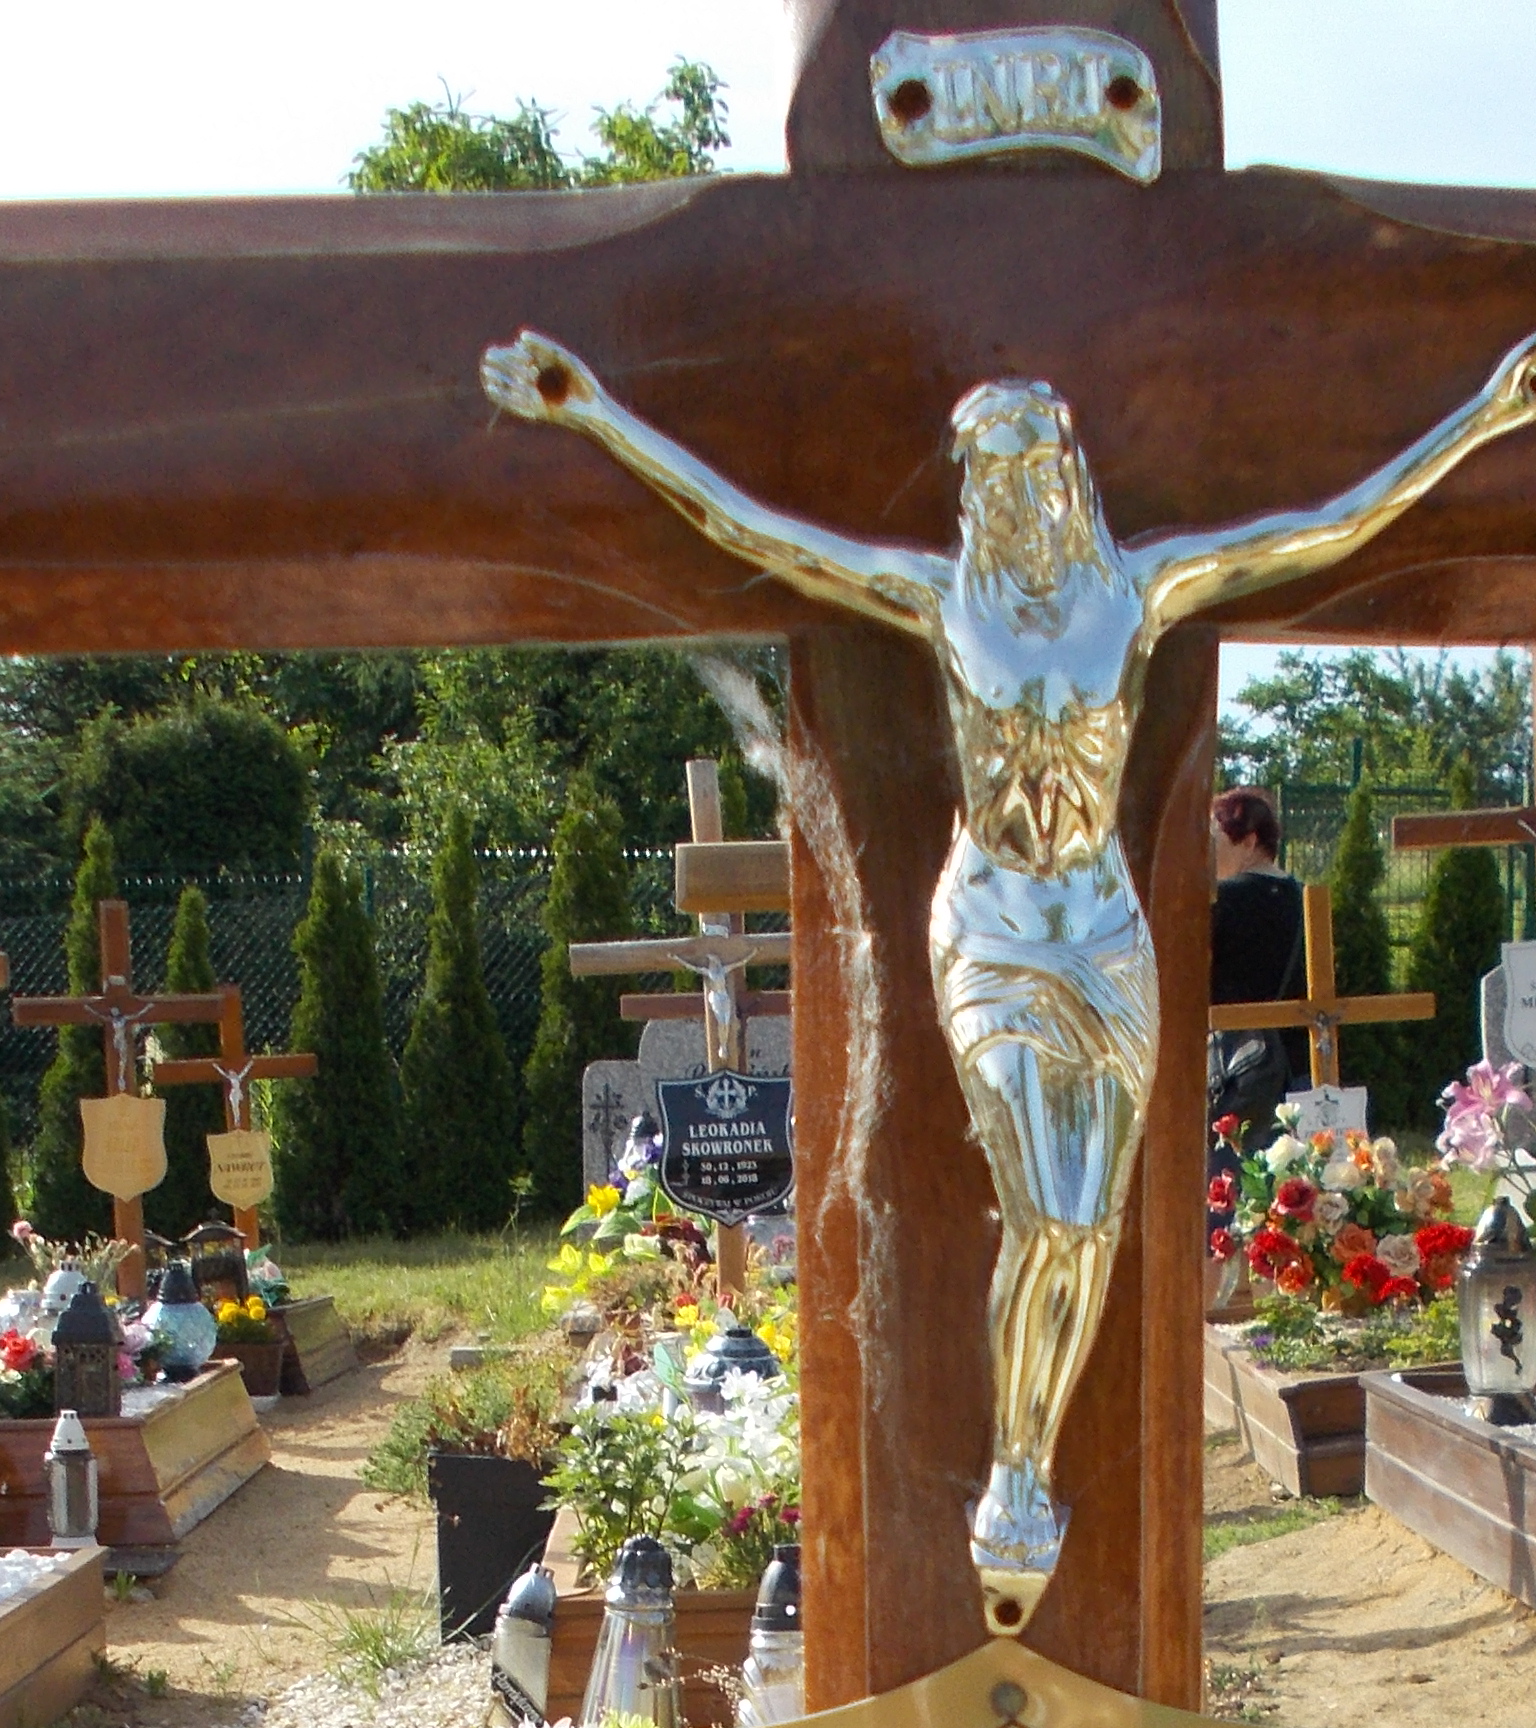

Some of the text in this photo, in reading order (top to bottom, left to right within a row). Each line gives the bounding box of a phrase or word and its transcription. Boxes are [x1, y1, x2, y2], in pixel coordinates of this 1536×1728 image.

[932, 53, 1112, 141] INRI
[689, 1121, 767, 1139] LEOKADIA
[682, 1139, 773, 1157] SKOWRONEK
